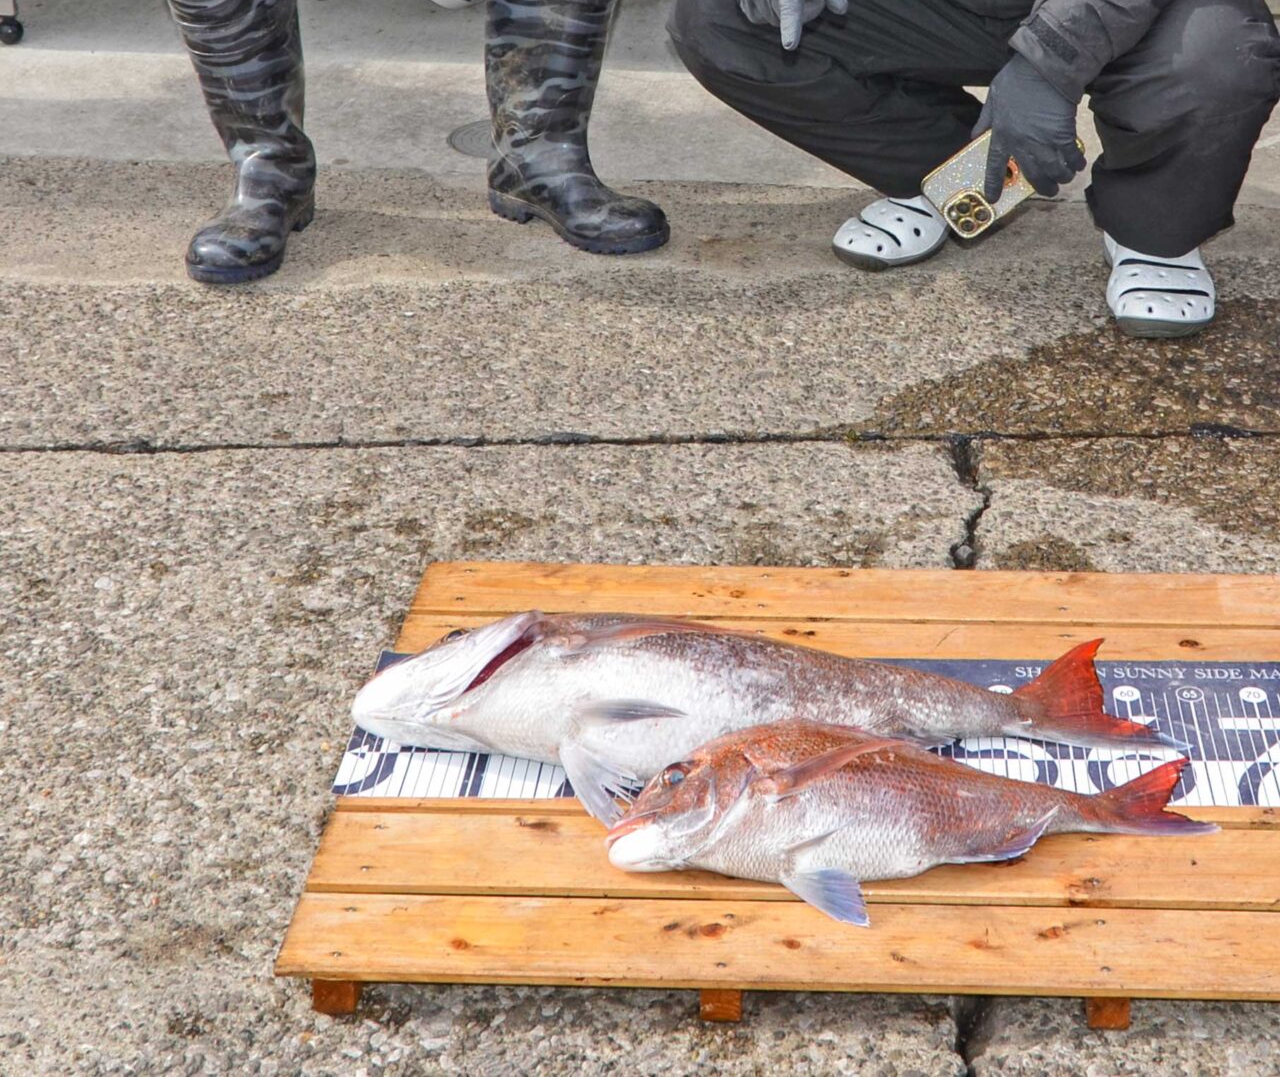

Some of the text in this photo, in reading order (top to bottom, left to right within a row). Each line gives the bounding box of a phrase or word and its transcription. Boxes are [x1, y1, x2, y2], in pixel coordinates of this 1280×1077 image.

[1114, 667, 1187, 679] SUNNY
[1194, 667, 1243, 679] SIDE
[1120, 689, 1134, 697] 60
[1182, 689, 1198, 698] 65
[1246, 690, 1261, 698] 70
